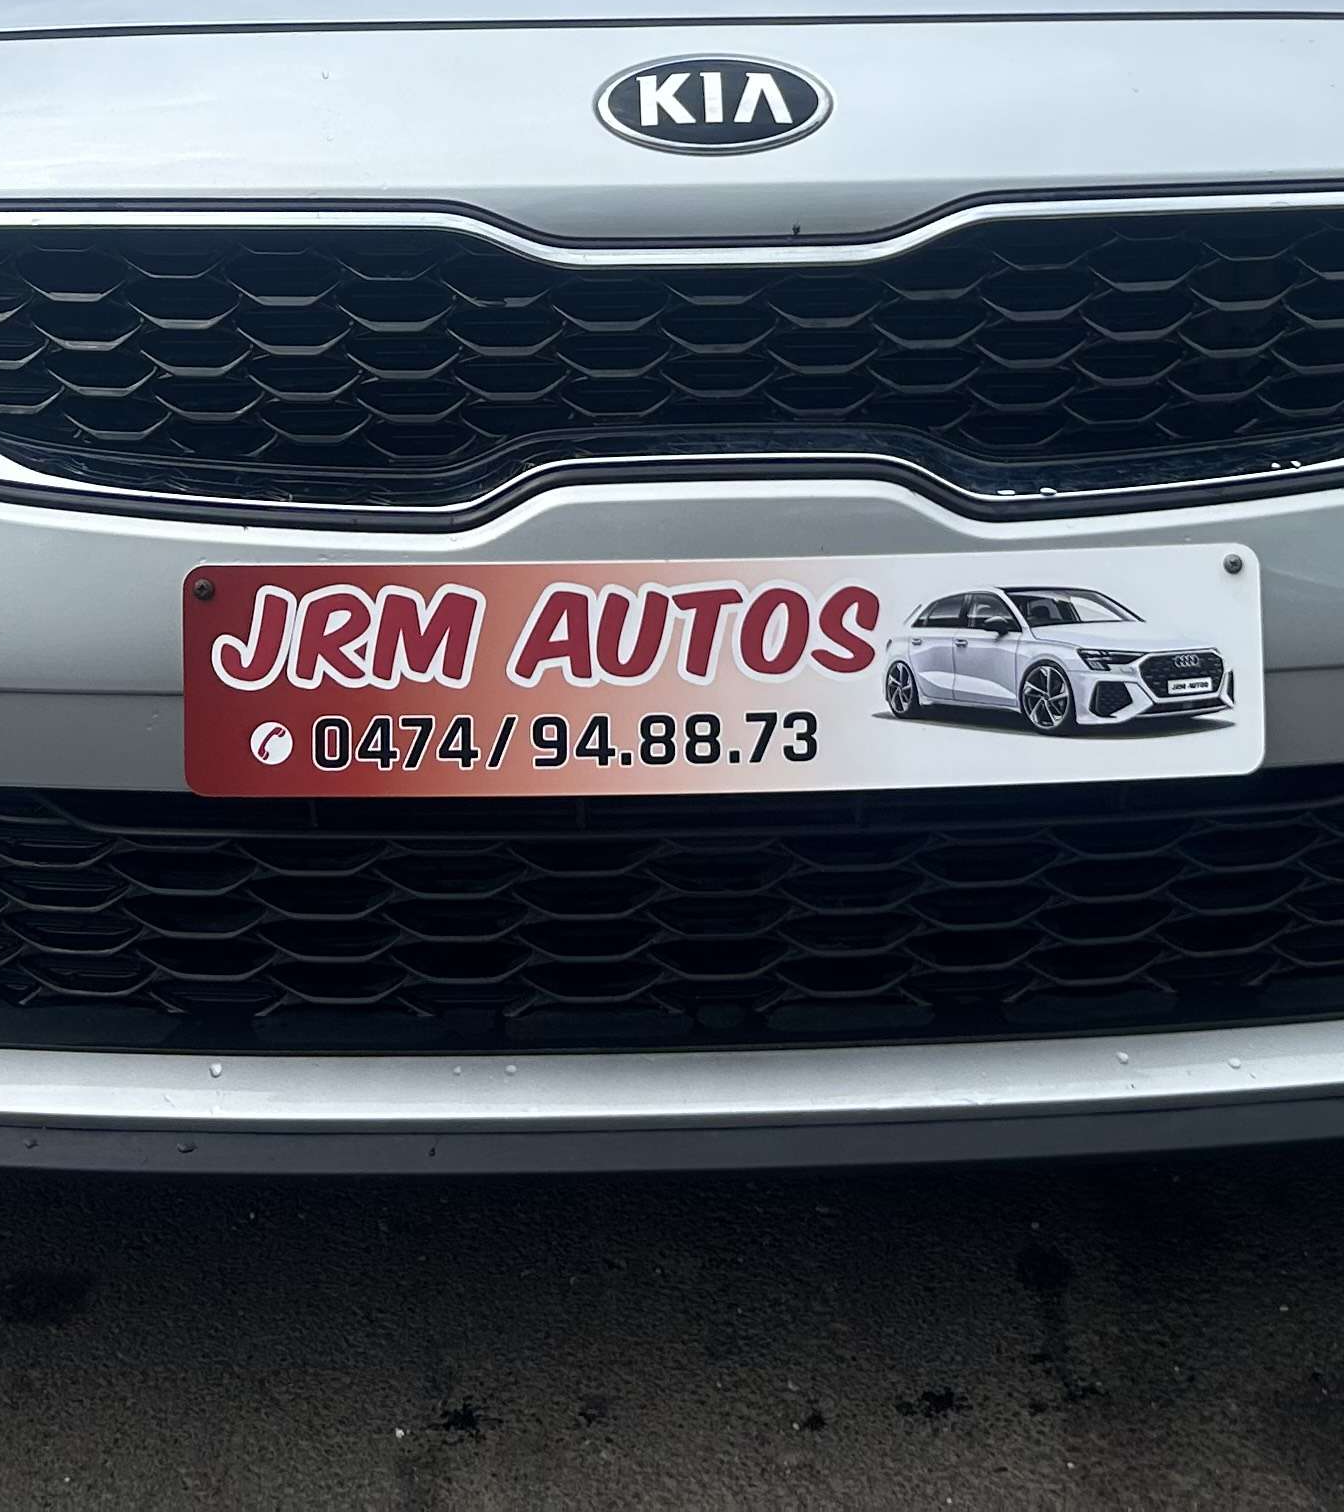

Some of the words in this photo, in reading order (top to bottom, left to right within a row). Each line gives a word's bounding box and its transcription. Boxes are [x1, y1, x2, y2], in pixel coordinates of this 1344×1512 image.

[635, 71, 794, 127] KIA
[213, 585, 484, 689] JRM
[509, 581, 883, 685] AUTOS
